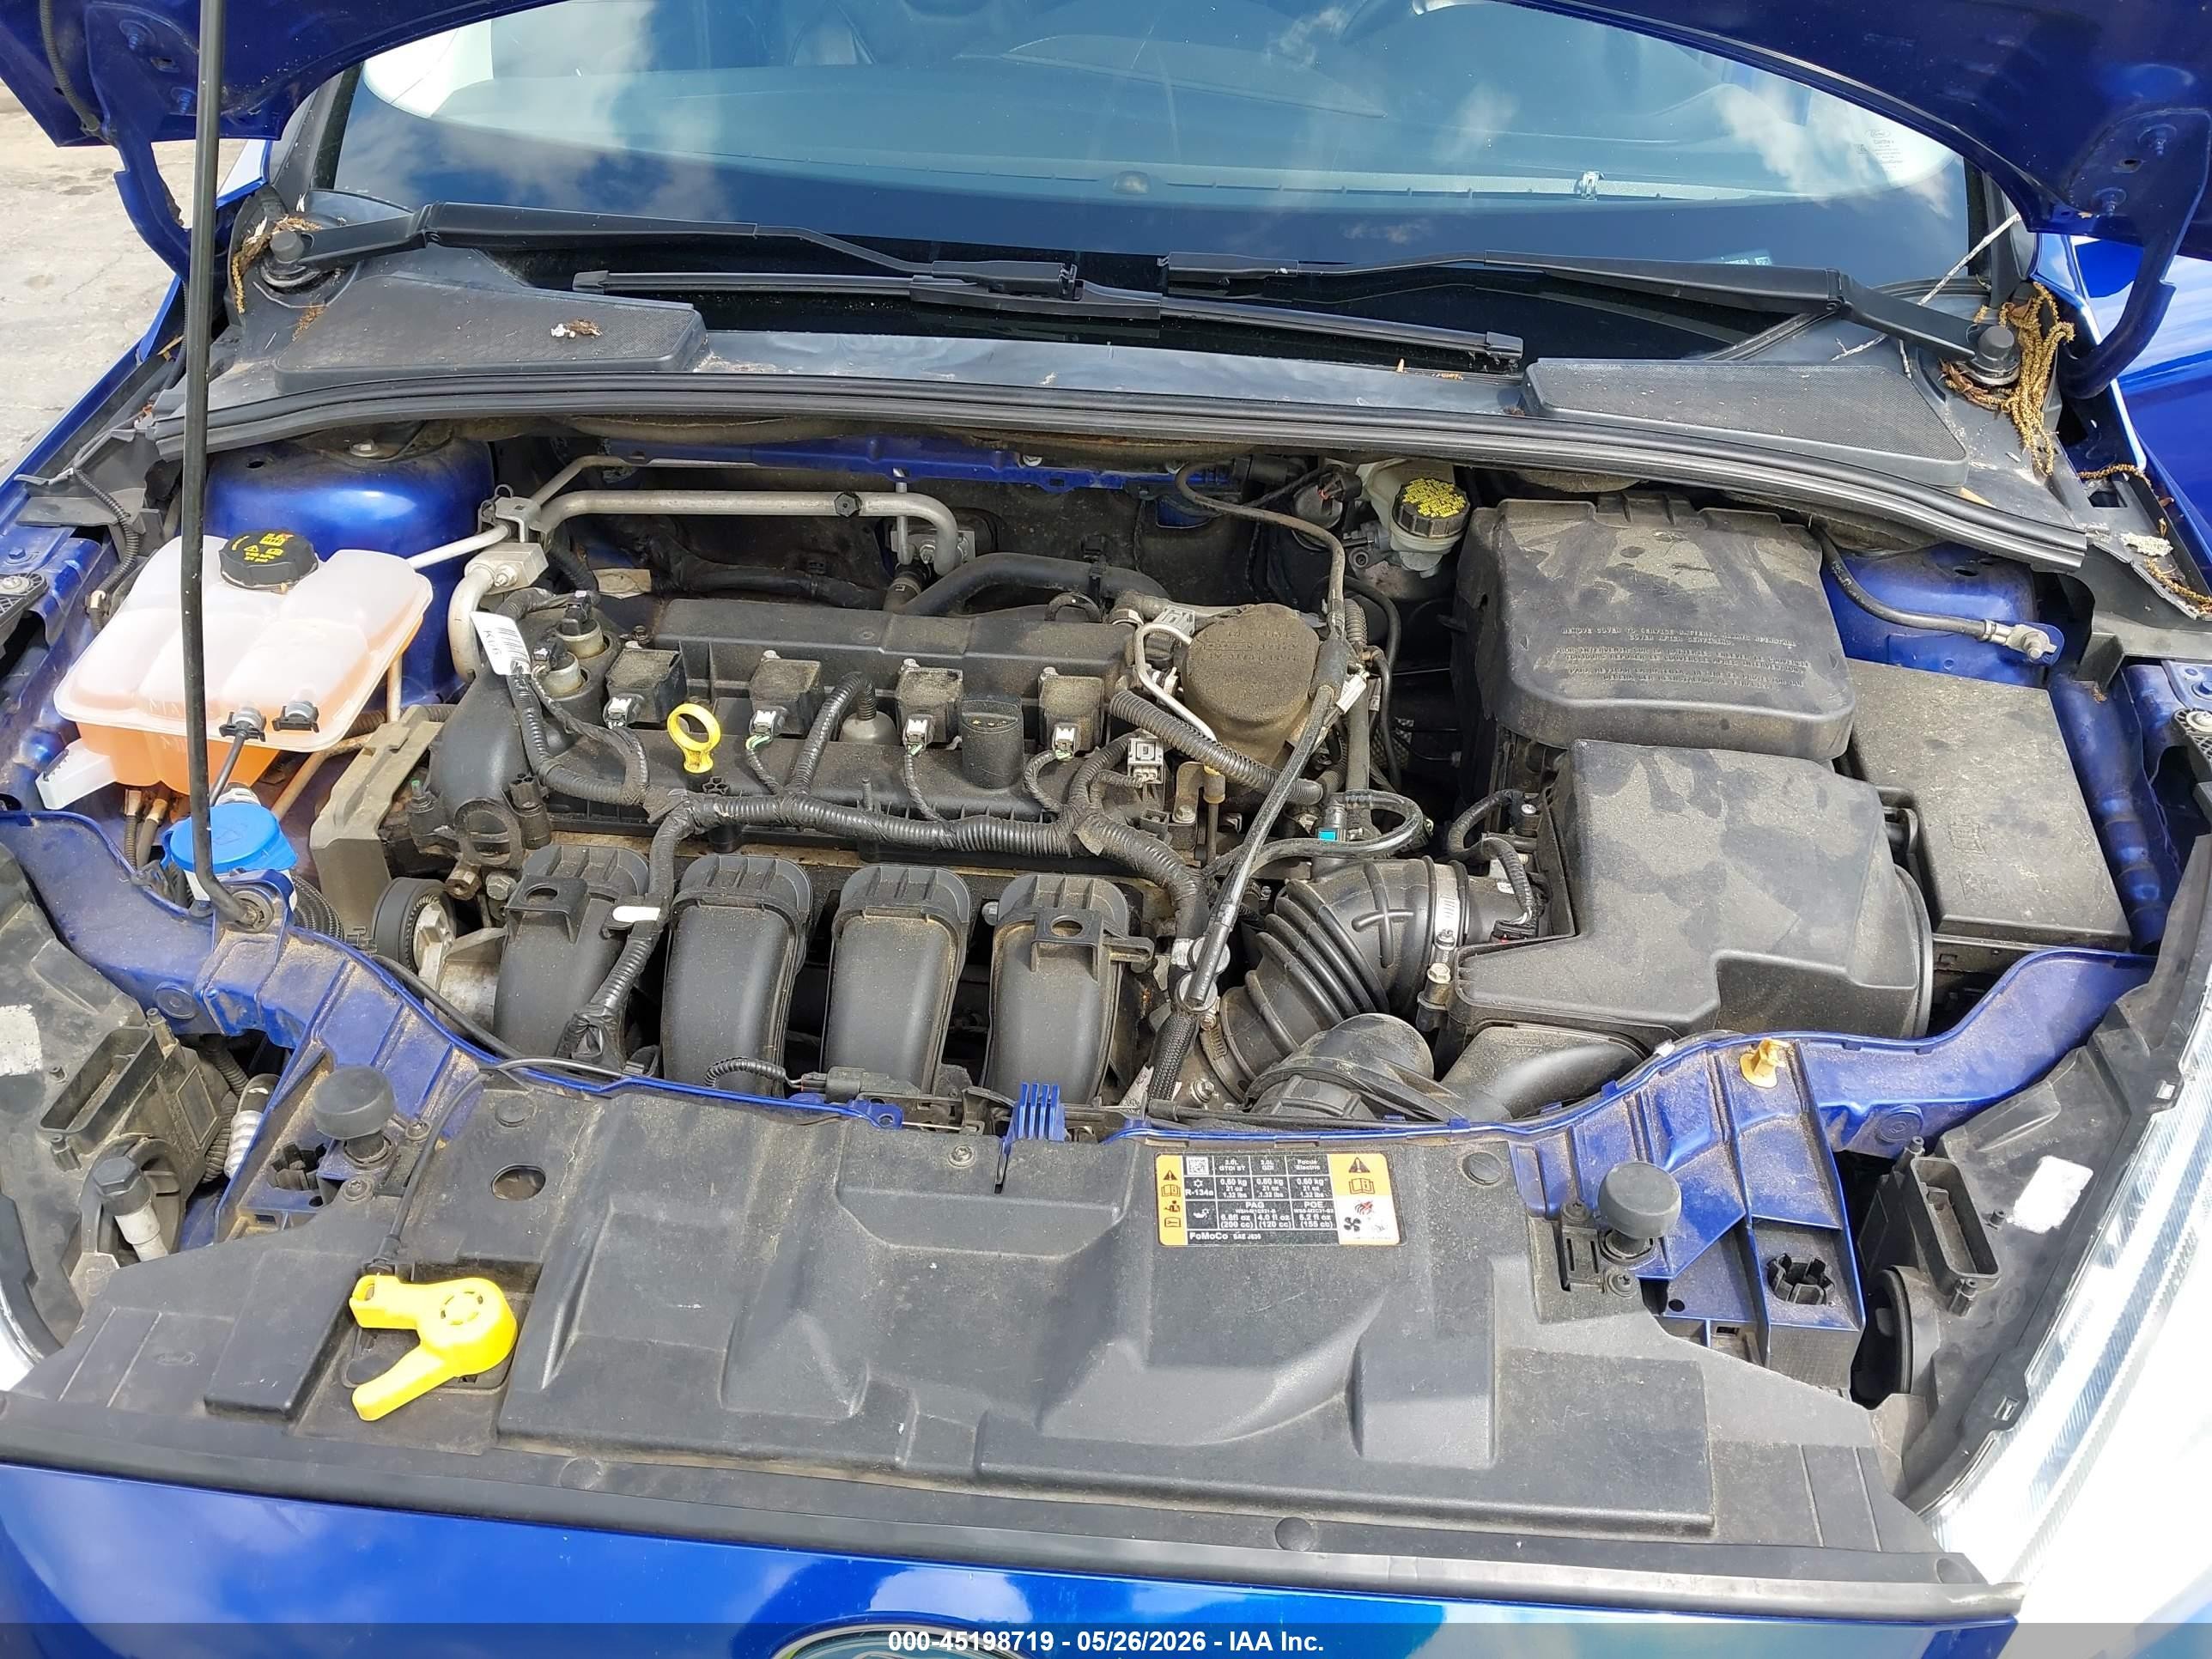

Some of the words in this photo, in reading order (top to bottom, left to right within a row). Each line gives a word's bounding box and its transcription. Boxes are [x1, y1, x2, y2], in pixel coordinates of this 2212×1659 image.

[1595, 626, 1622, 635] COVER
[1237, 1178, 1248, 1187] kg
[1273, 1177, 1284, 1187] kg
[1314, 1177, 1324, 1187] kg
